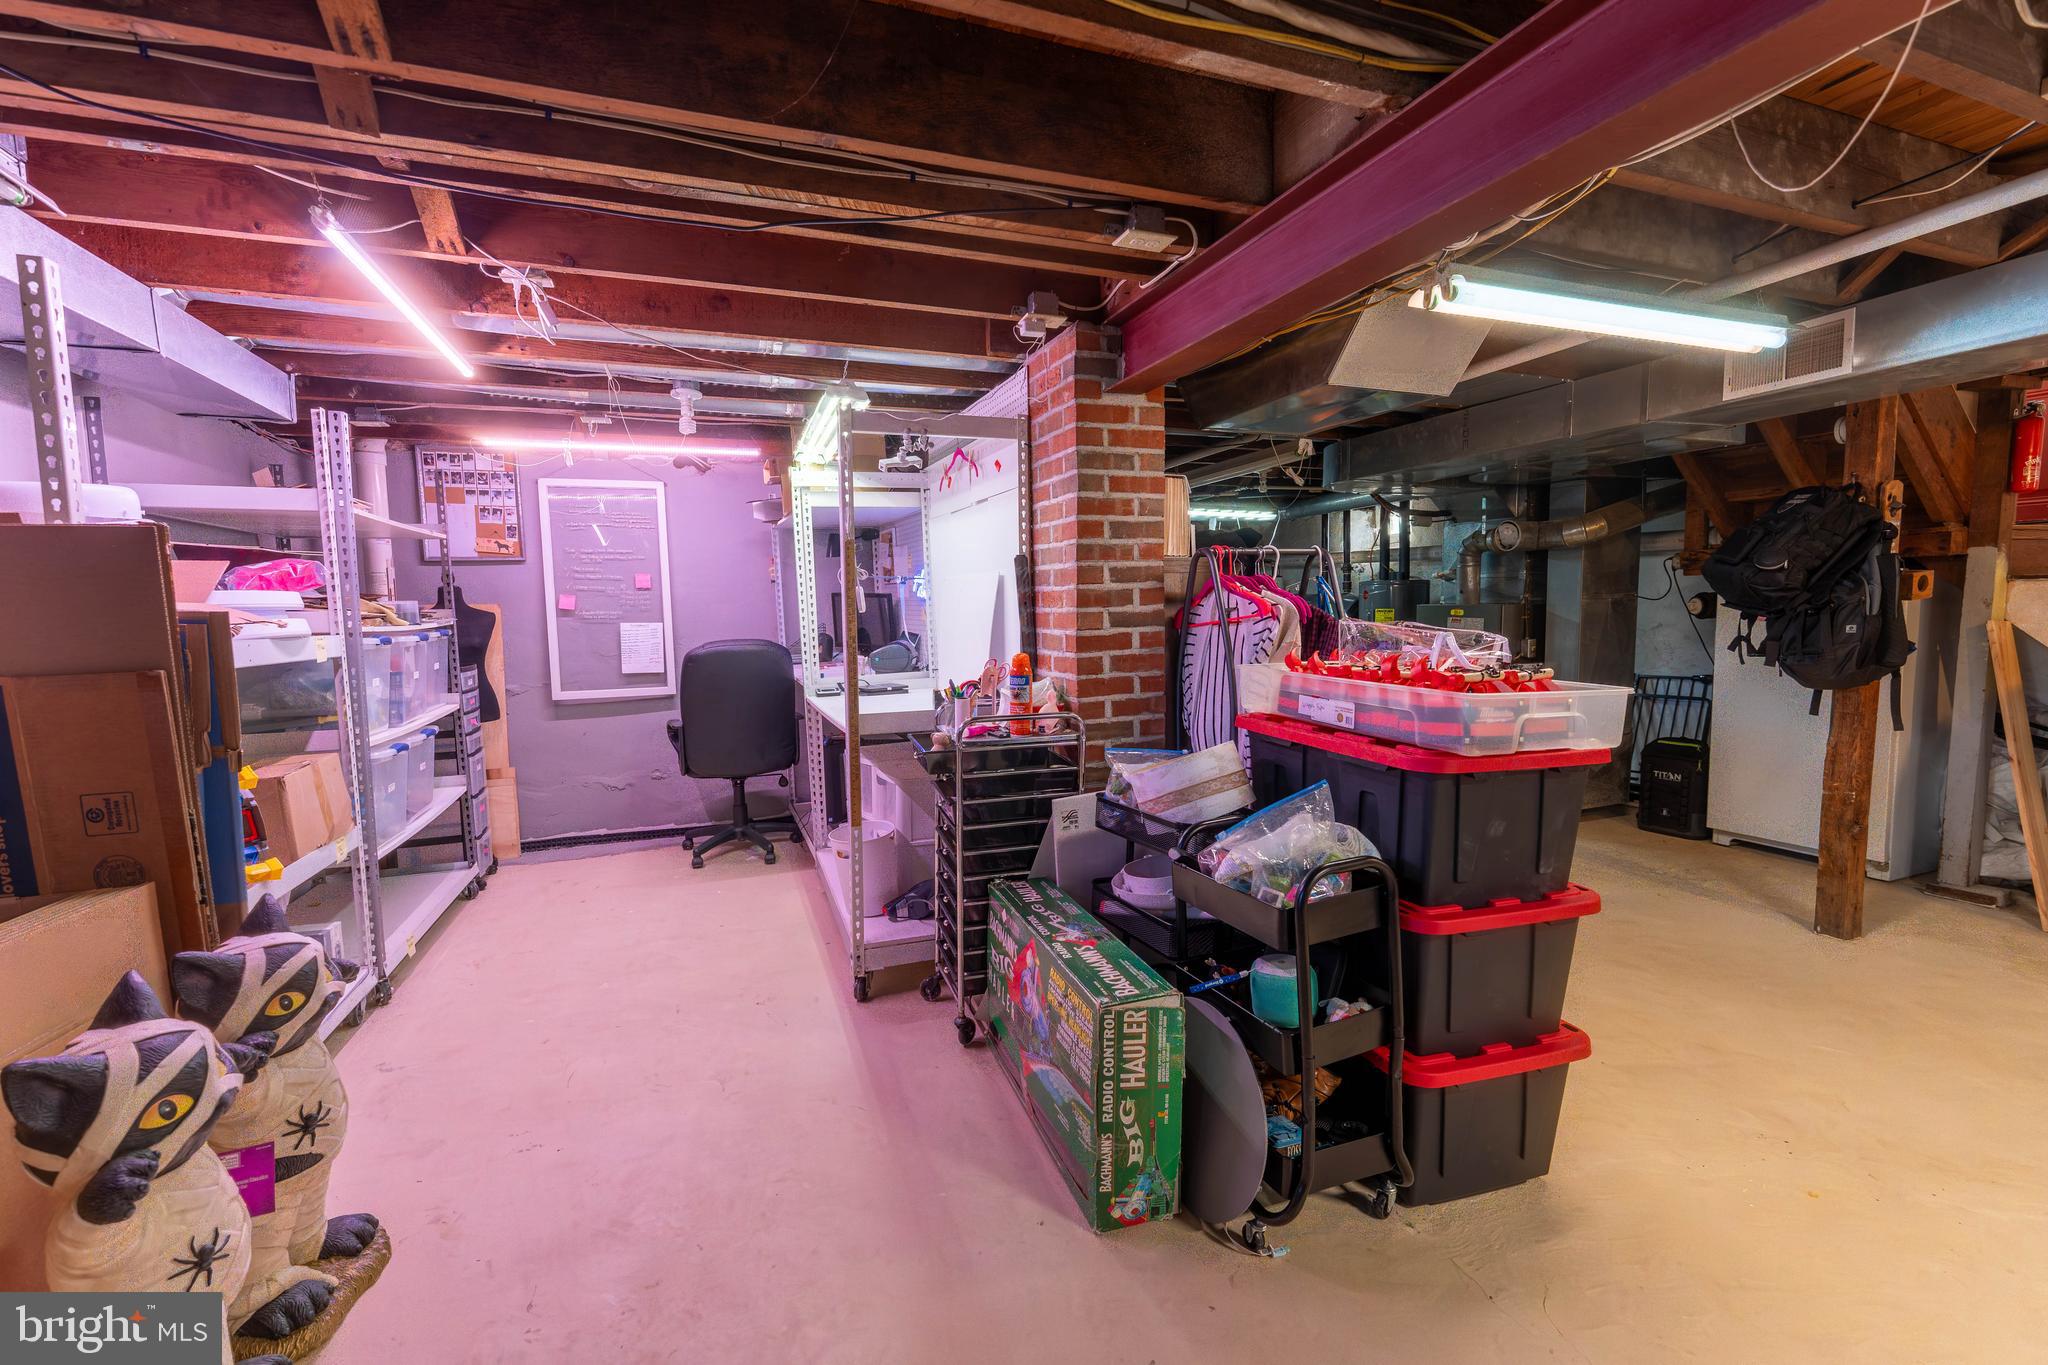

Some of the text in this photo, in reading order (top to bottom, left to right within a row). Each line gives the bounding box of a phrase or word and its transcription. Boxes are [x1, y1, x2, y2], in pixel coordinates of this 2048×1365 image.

[1653, 770, 1681, 781] TITAN
[991, 943, 1015, 982] BIG
[1051, 942, 1072, 959] RADIO
[1073, 944, 1140, 998] BACHMANN'S
[1050, 967, 1066, 992] RADIO
[1068, 987, 1093, 1024] CONTROL
[1120, 1009, 1148, 1089] HAULER
[1100, 1008, 1115, 1193] BACHMANN'S RADIO CONTROL
[1119, 1095, 1145, 1168] BIG
